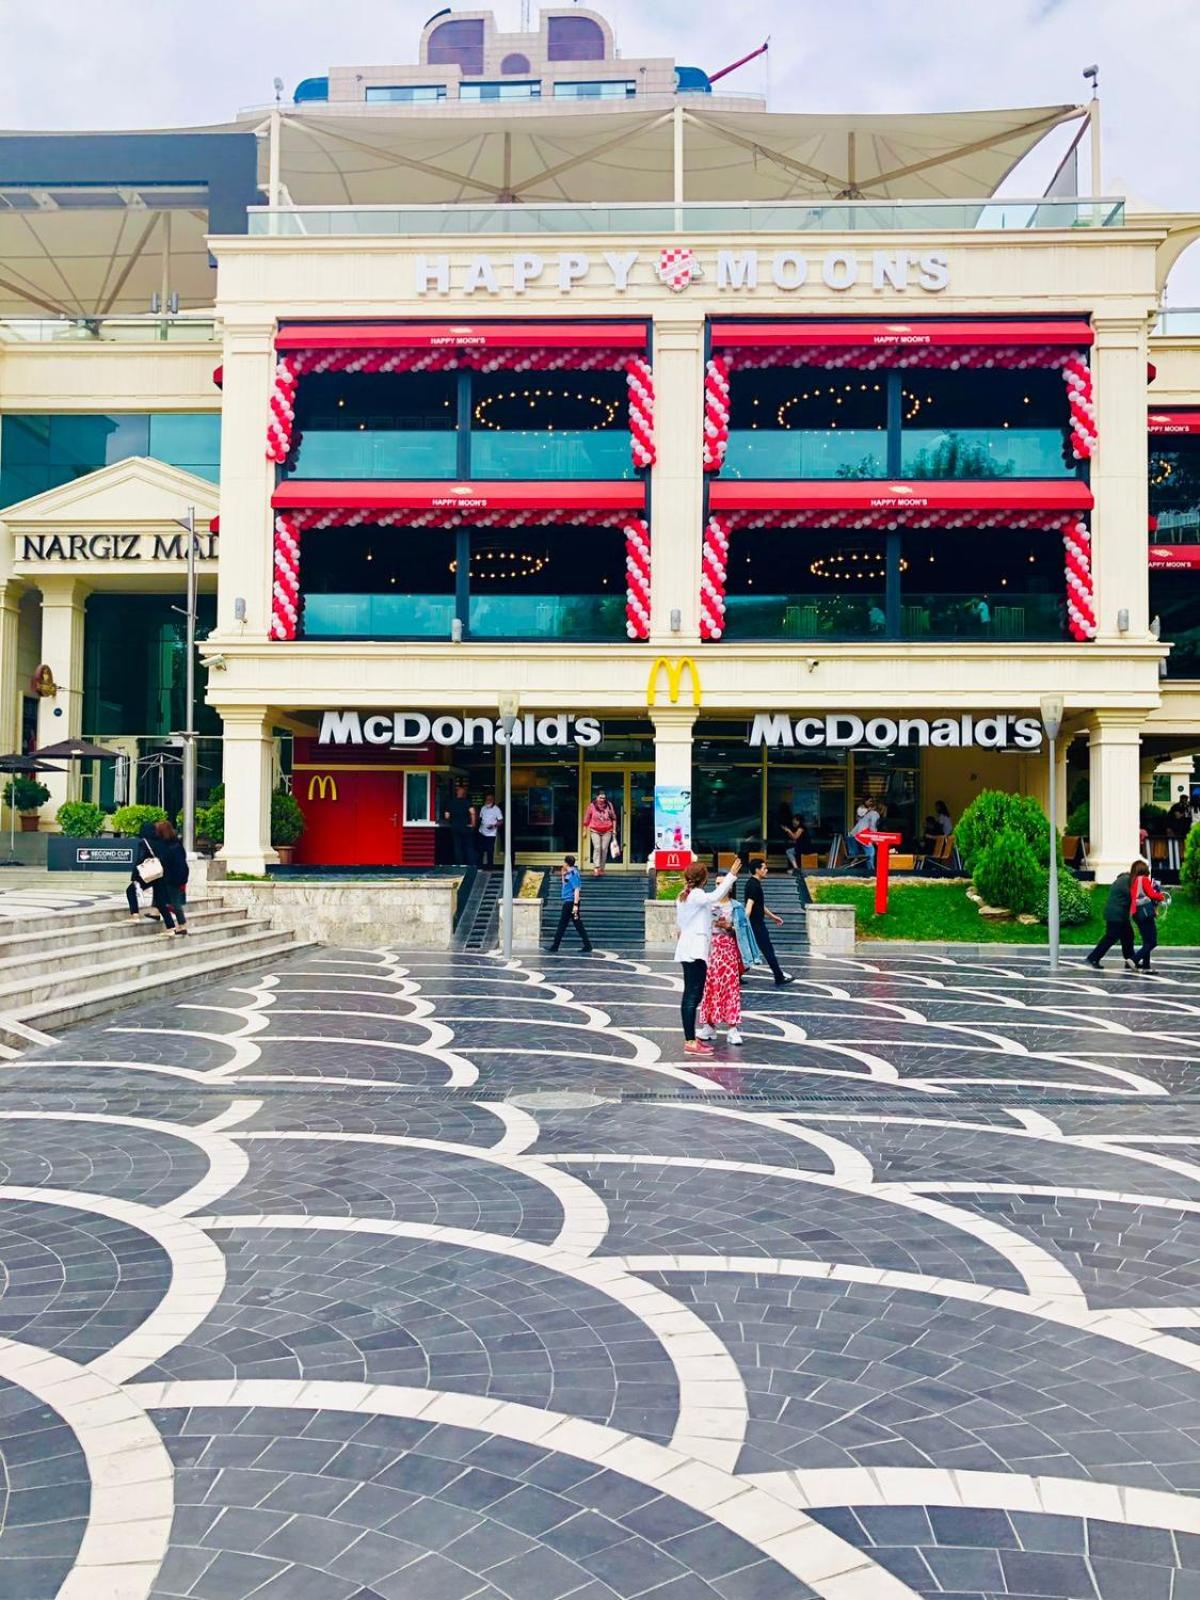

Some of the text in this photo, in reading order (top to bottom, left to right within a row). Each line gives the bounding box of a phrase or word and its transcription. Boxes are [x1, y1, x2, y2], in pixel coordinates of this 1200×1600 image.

[415, 251, 639, 295] HAPPY
[430, 337, 486, 345] HAPPY MOON'S
[873, 335, 930, 343] HAPPY MOON'S
[432, 498, 487, 506] HAPPY MOON'S
[870, 498, 928, 506] HAPPY MOON'S
[22, 534, 142, 560] NARGIZ
[318, 711, 601, 747] McDonald's
[750, 714, 1043, 748] McDonald's
